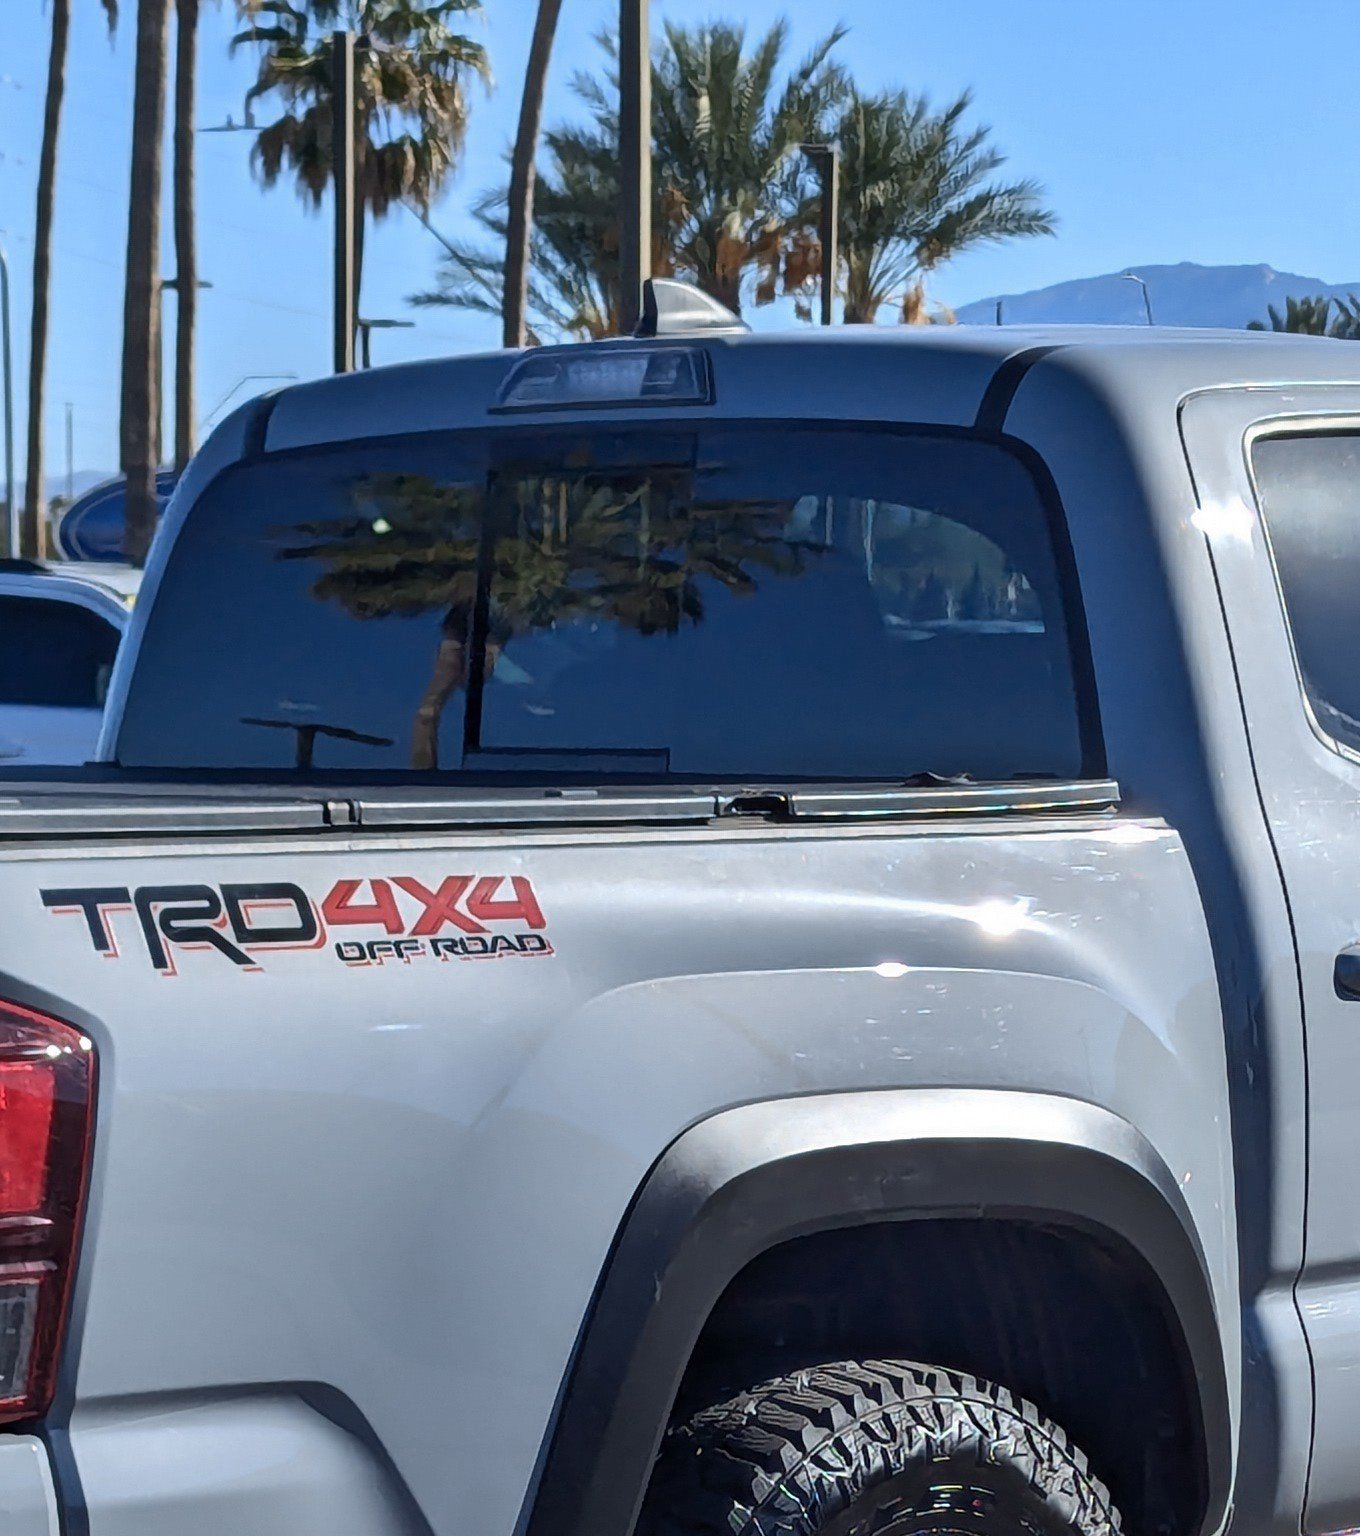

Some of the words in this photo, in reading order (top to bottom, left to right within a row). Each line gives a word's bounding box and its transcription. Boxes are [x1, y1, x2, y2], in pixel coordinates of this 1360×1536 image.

[39, 881, 326, 978] TRD
[322, 874, 547, 936] 4X4
[334, 938, 426, 968] OFF
[431, 932, 554, 962] ROAD
